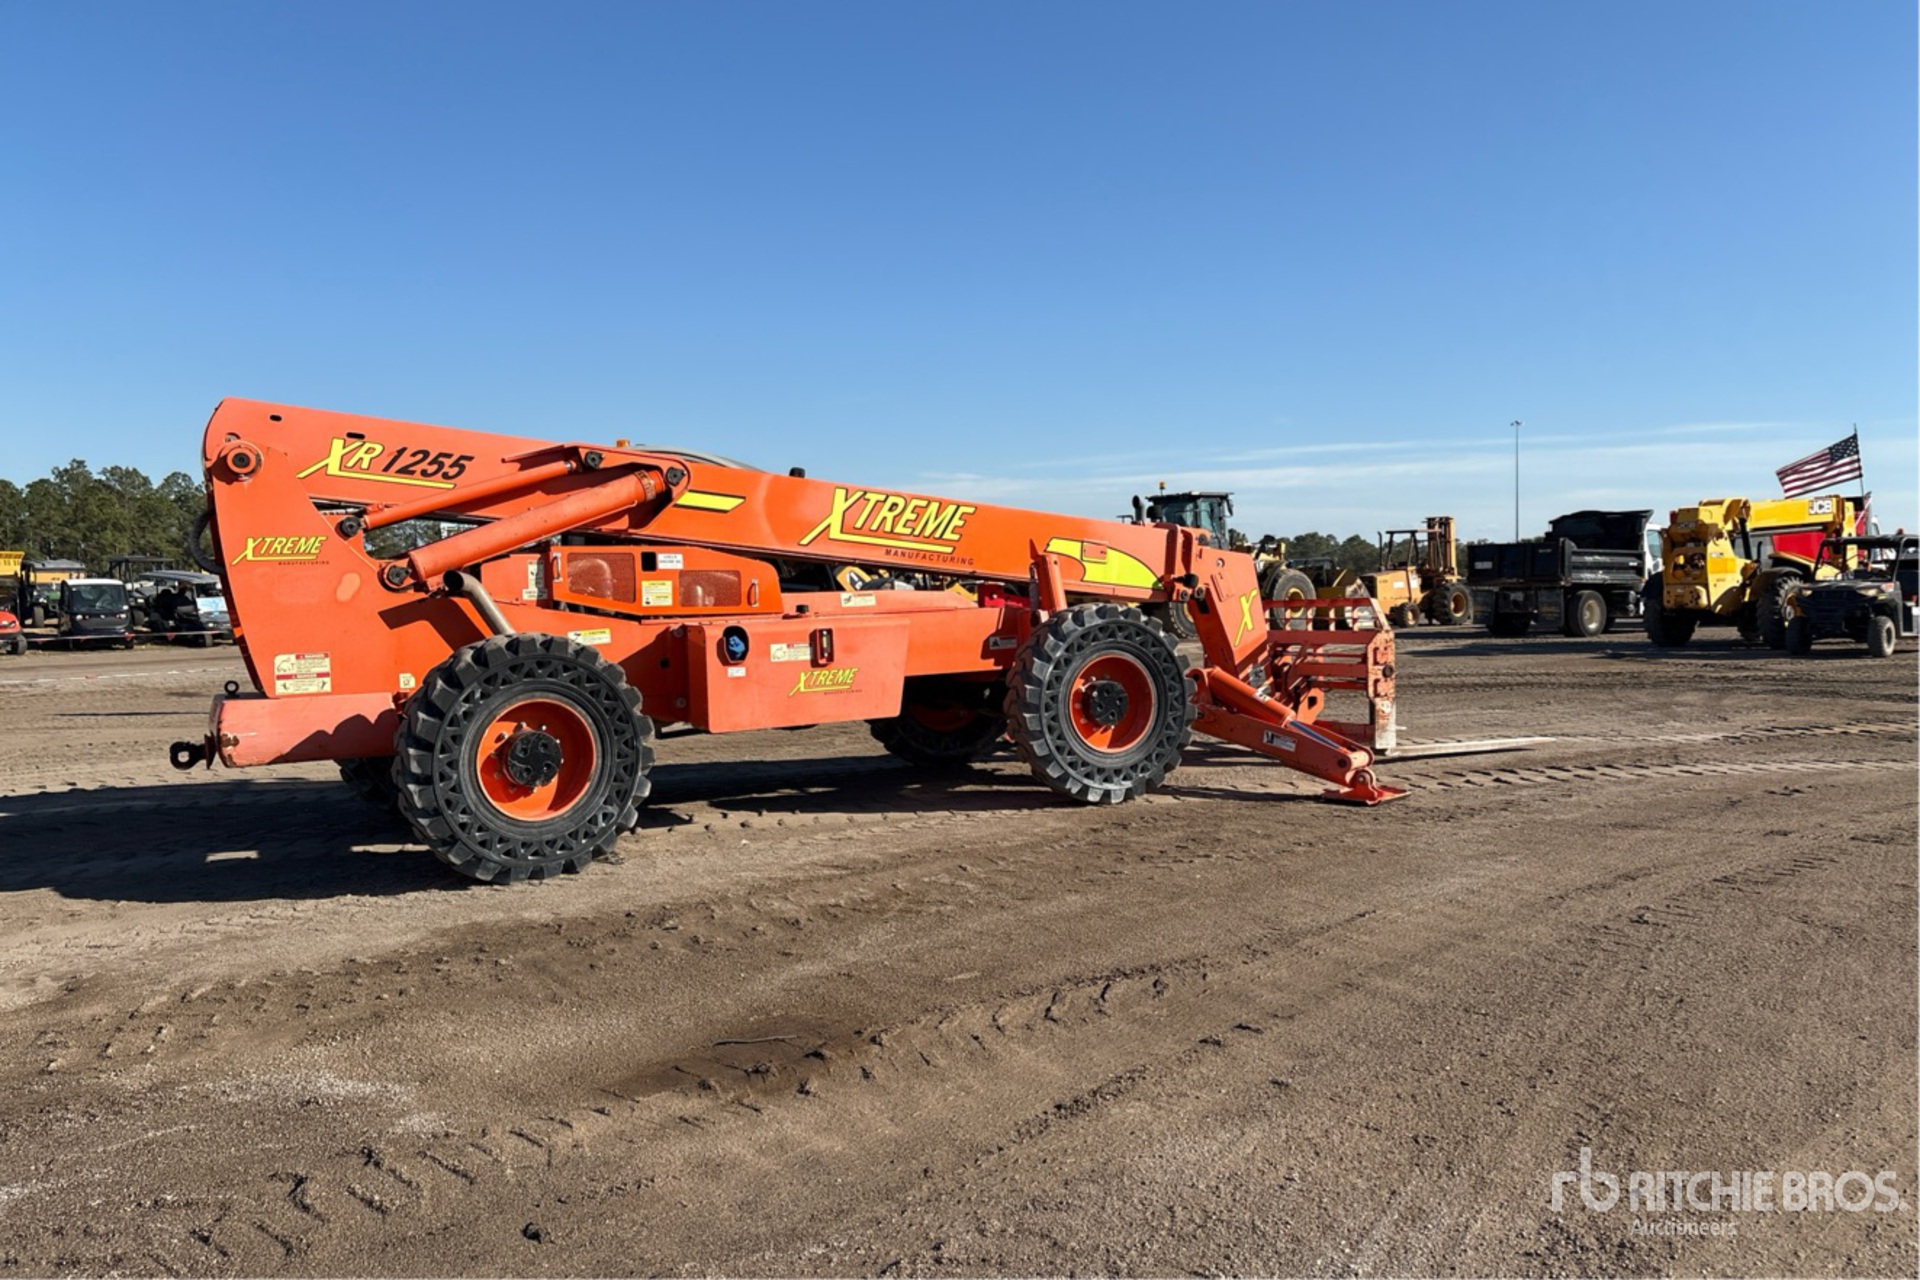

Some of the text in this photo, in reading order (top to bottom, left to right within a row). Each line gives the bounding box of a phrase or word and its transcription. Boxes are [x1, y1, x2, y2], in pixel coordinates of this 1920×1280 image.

[296, 437, 476, 481] XR 1255
[798, 487, 976, 549] XTREME
[1809, 499, 1833, 515] JCB
[231, 535, 328, 566] XTREME
[885, 548, 975, 566] MANUFACTURING
[788, 667, 860, 697] XTREME
